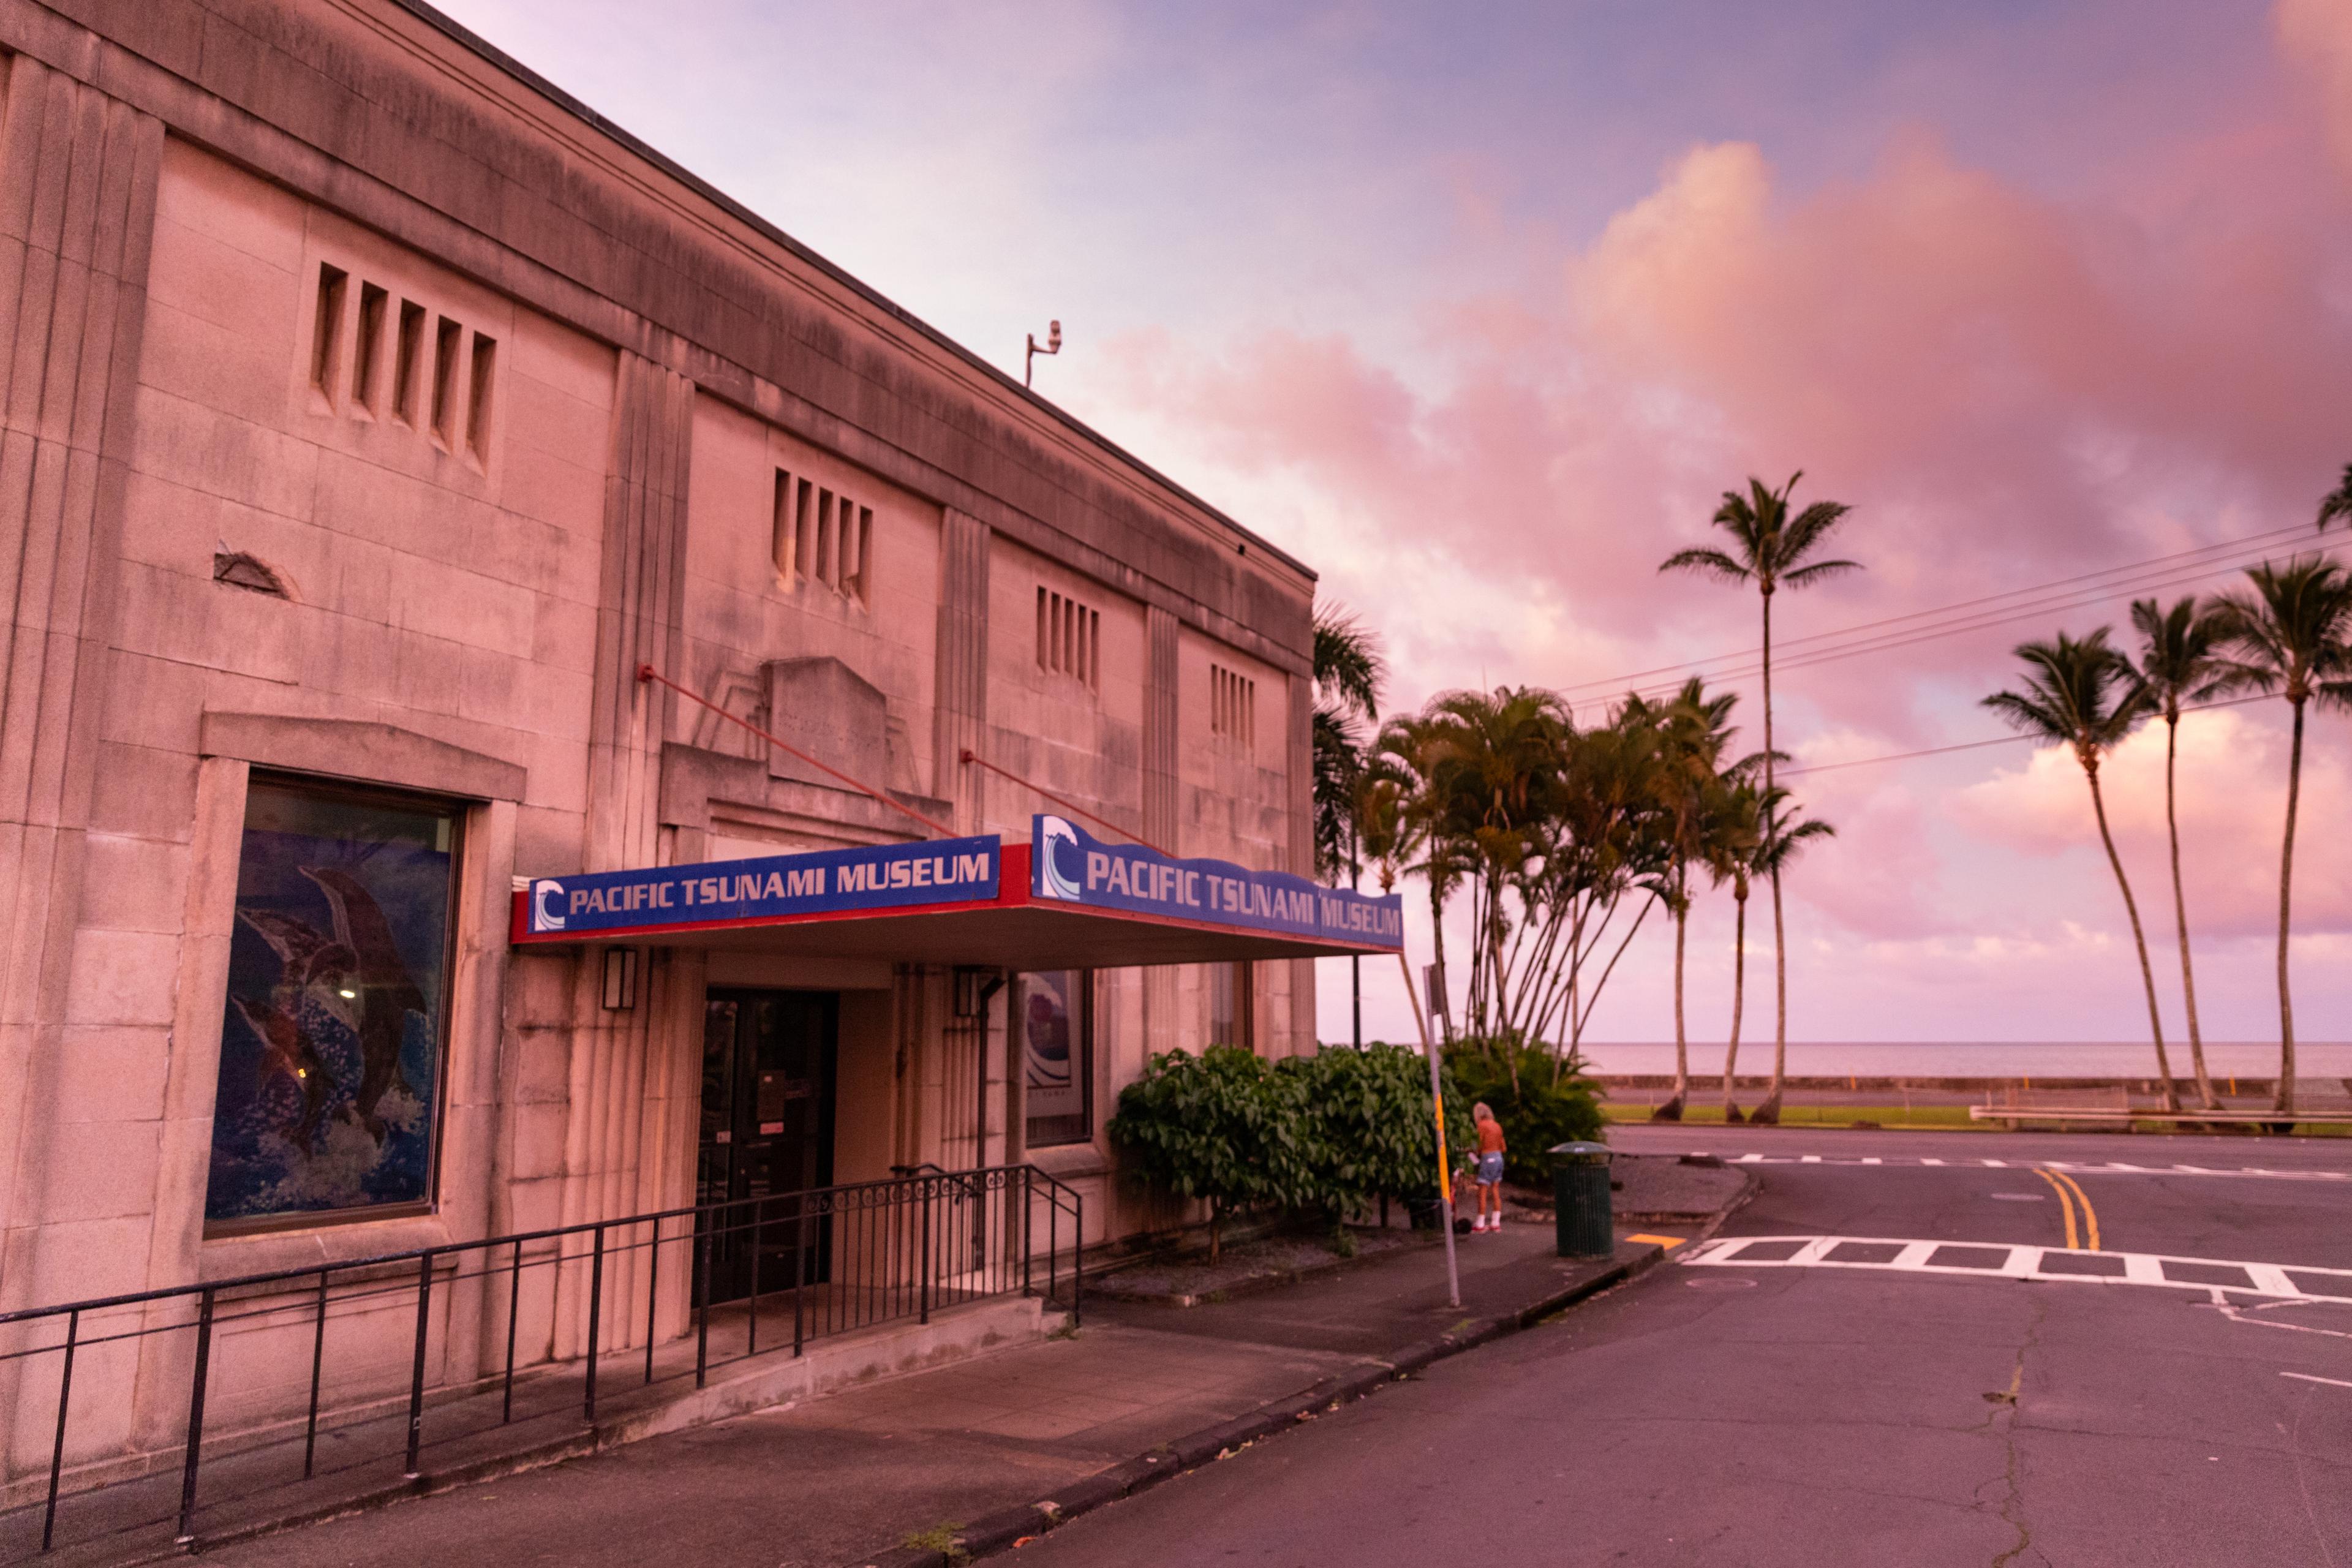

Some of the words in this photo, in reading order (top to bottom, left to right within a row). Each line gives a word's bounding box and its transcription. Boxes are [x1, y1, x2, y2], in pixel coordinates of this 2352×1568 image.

[570, 881, 674, 915] PACIFIC
[680, 867, 825, 905] TSUNAMI
[837, 853, 990, 893] MUSEUM
[1087, 851, 1200, 907] PACIFIC
[1206, 874, 1314, 924] TSUNAMI
[1321, 897, 1400, 937] MUSEUM
